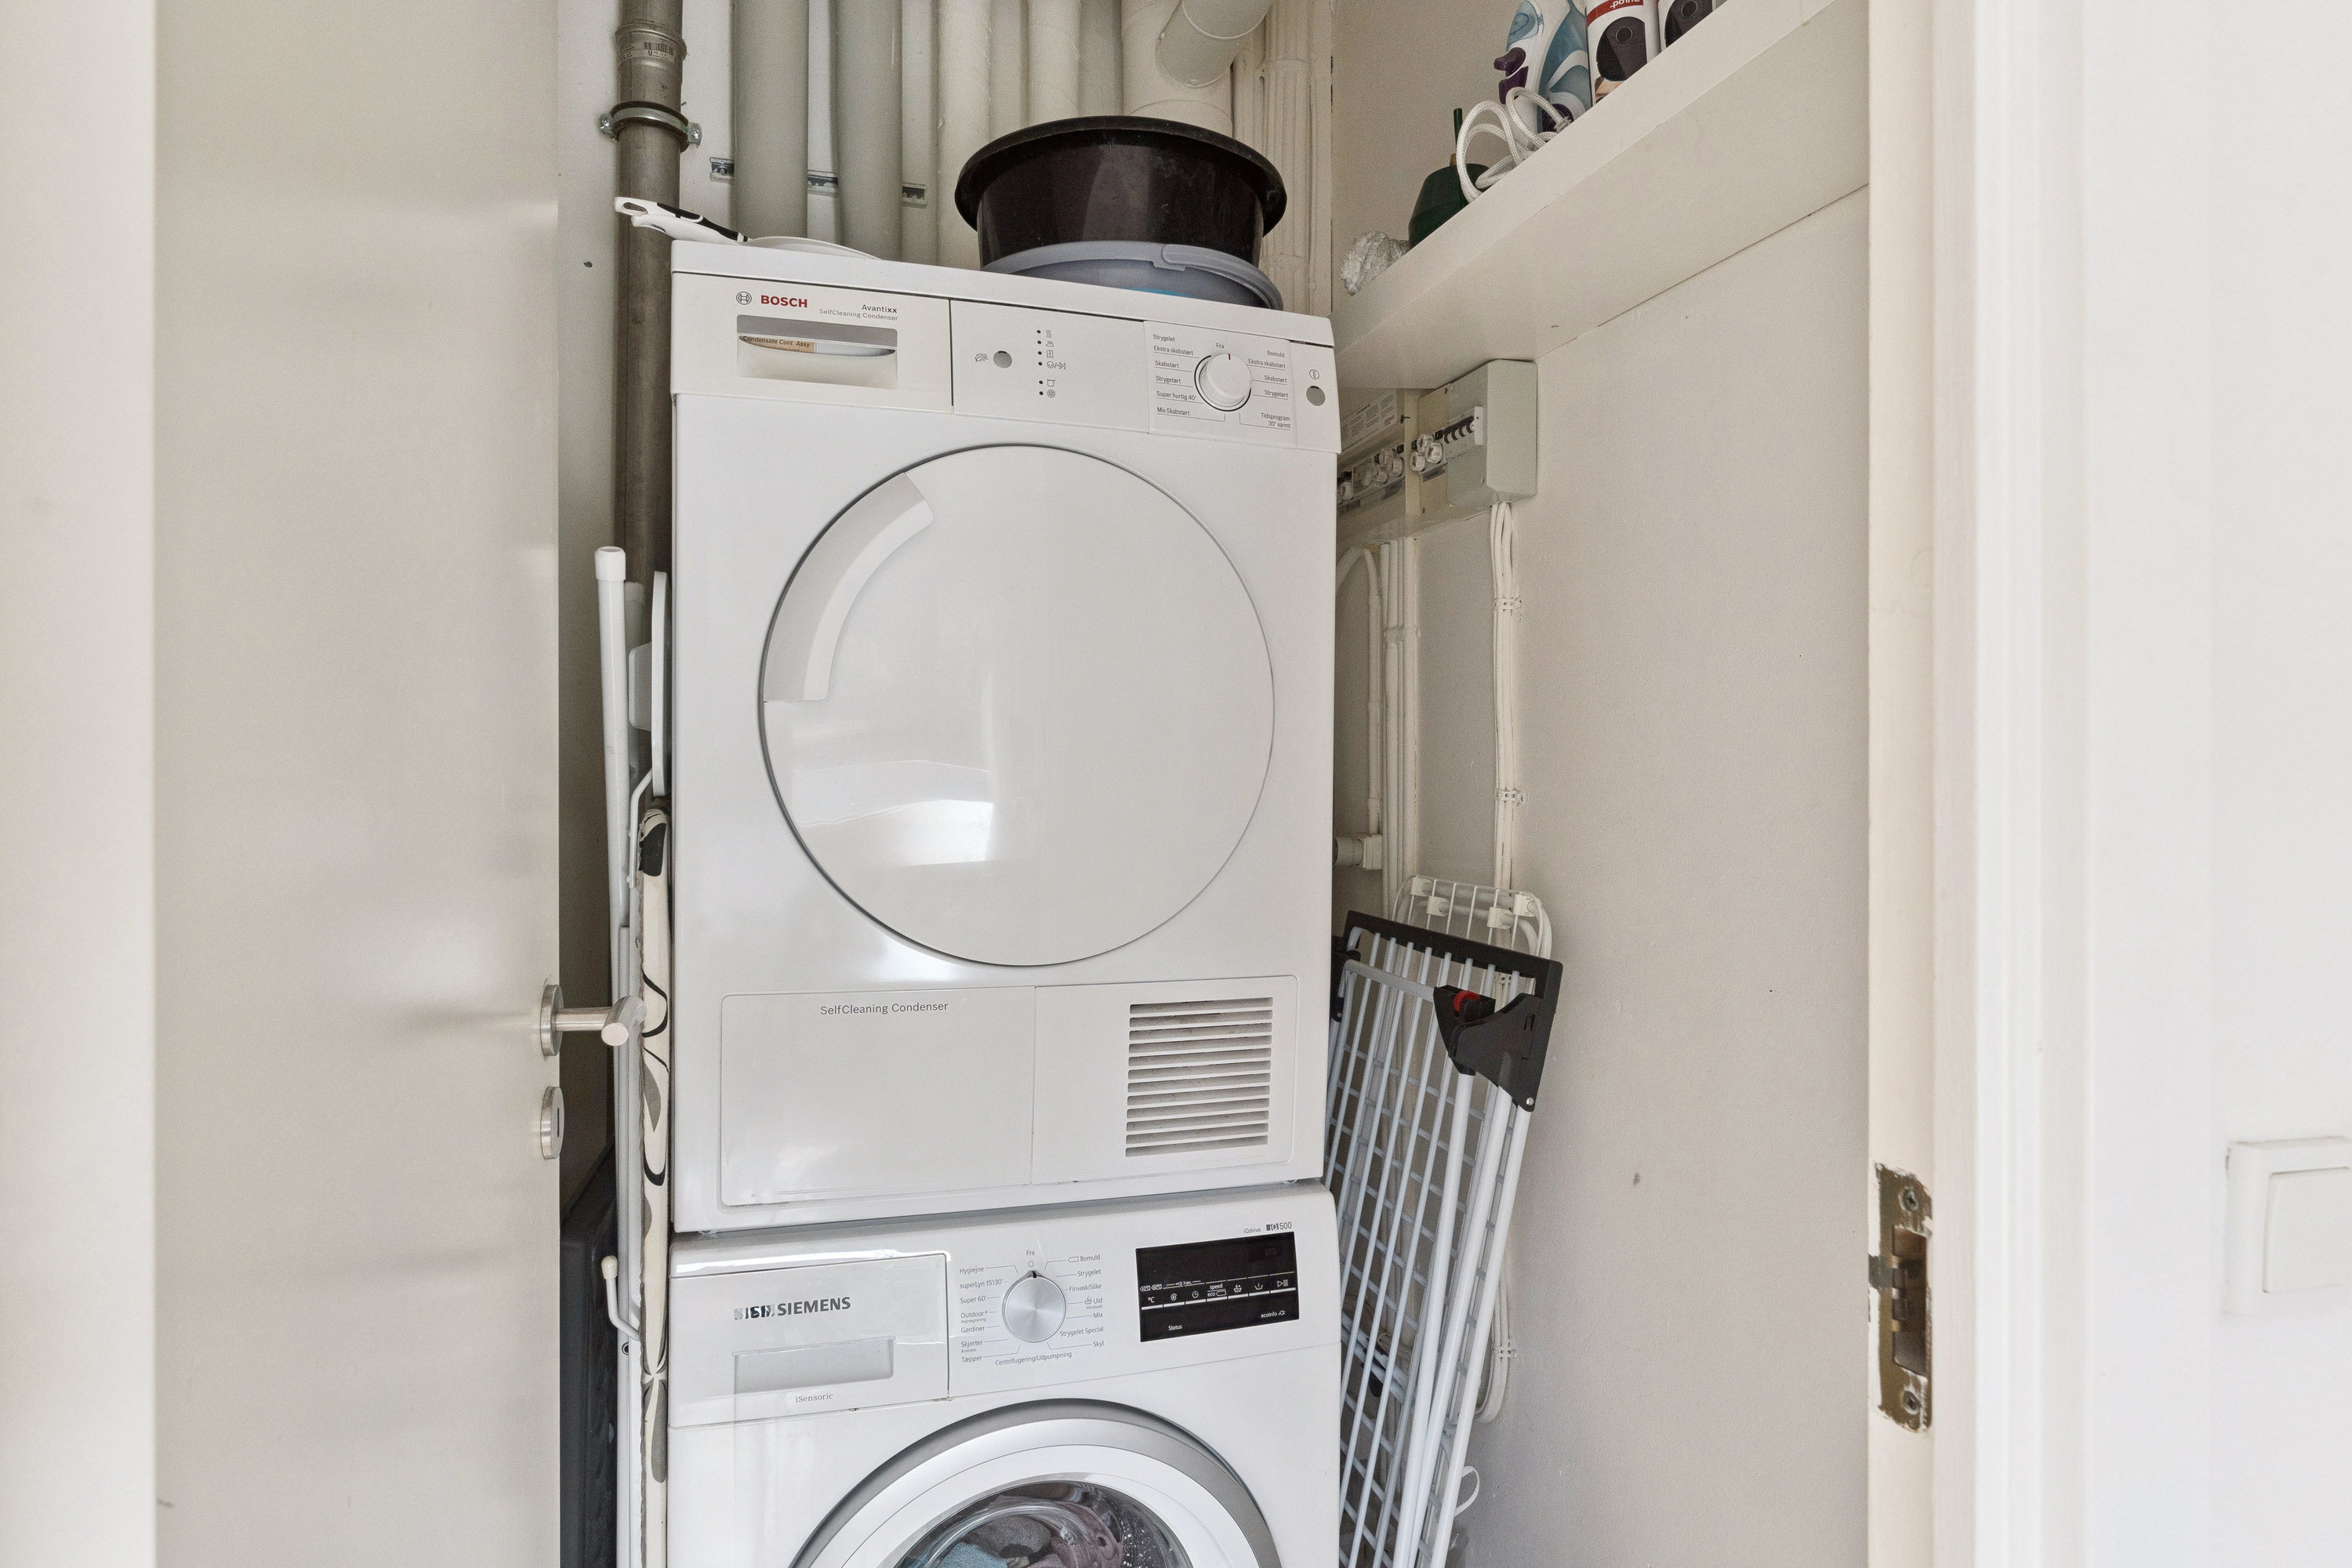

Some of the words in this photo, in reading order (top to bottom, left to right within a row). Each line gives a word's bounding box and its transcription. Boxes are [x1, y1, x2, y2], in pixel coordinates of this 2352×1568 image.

[760, 295, 808, 308] BOSCH
[862, 304, 898, 314] Avantixx
[819, 309, 861, 318] SelfCleaning
[862, 312, 898, 321] Condenser
[742, 336, 778, 344] Condensate
[1267, 350, 1285, 358] Bomuld
[1261, 412, 1290, 422] Tidsprogram
[820, 1004, 888, 1014] SelfCleaning
[891, 1003, 949, 1012] Condenser
[959, 1266, 985, 1275] Hygiejne
[1077, 1269, 1102, 1277] Strygelet
[777, 1297, 851, 1316] SIEMENS
[1060, 1329, 1083, 1338] Strygelet
[960, 1340, 983, 1348] Skjorter
[795, 1392, 833, 1403] iSensoric
